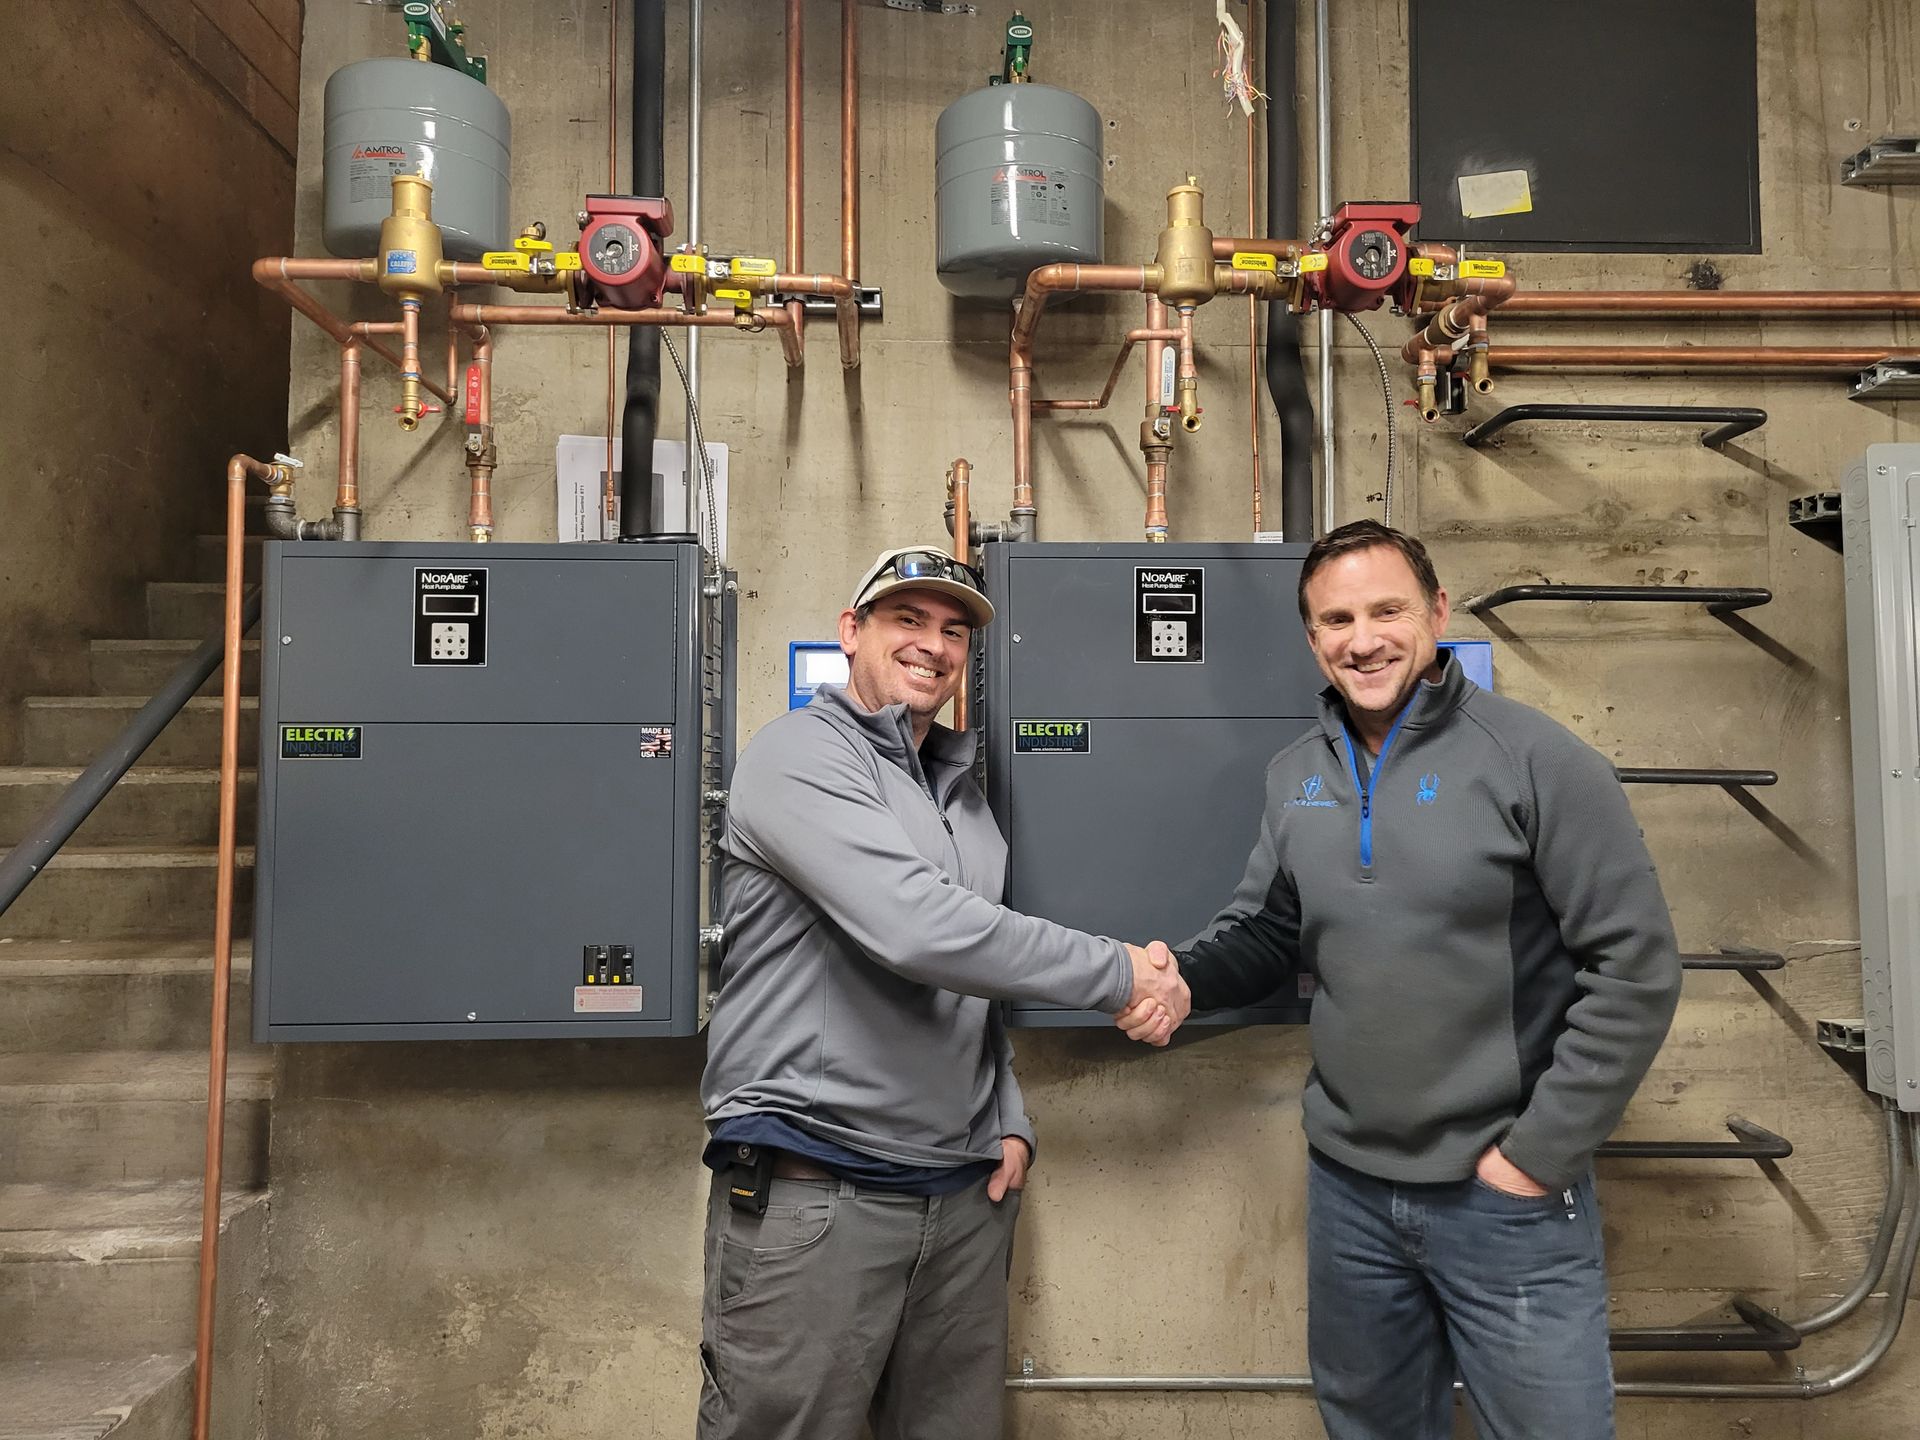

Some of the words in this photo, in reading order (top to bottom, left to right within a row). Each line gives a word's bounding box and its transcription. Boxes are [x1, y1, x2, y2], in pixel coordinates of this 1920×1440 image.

[365, 145, 405, 154] AMTROL
[286, 741, 357, 753] INDUSTRIES
[1019, 736, 1085, 747] INDUSTRIES
